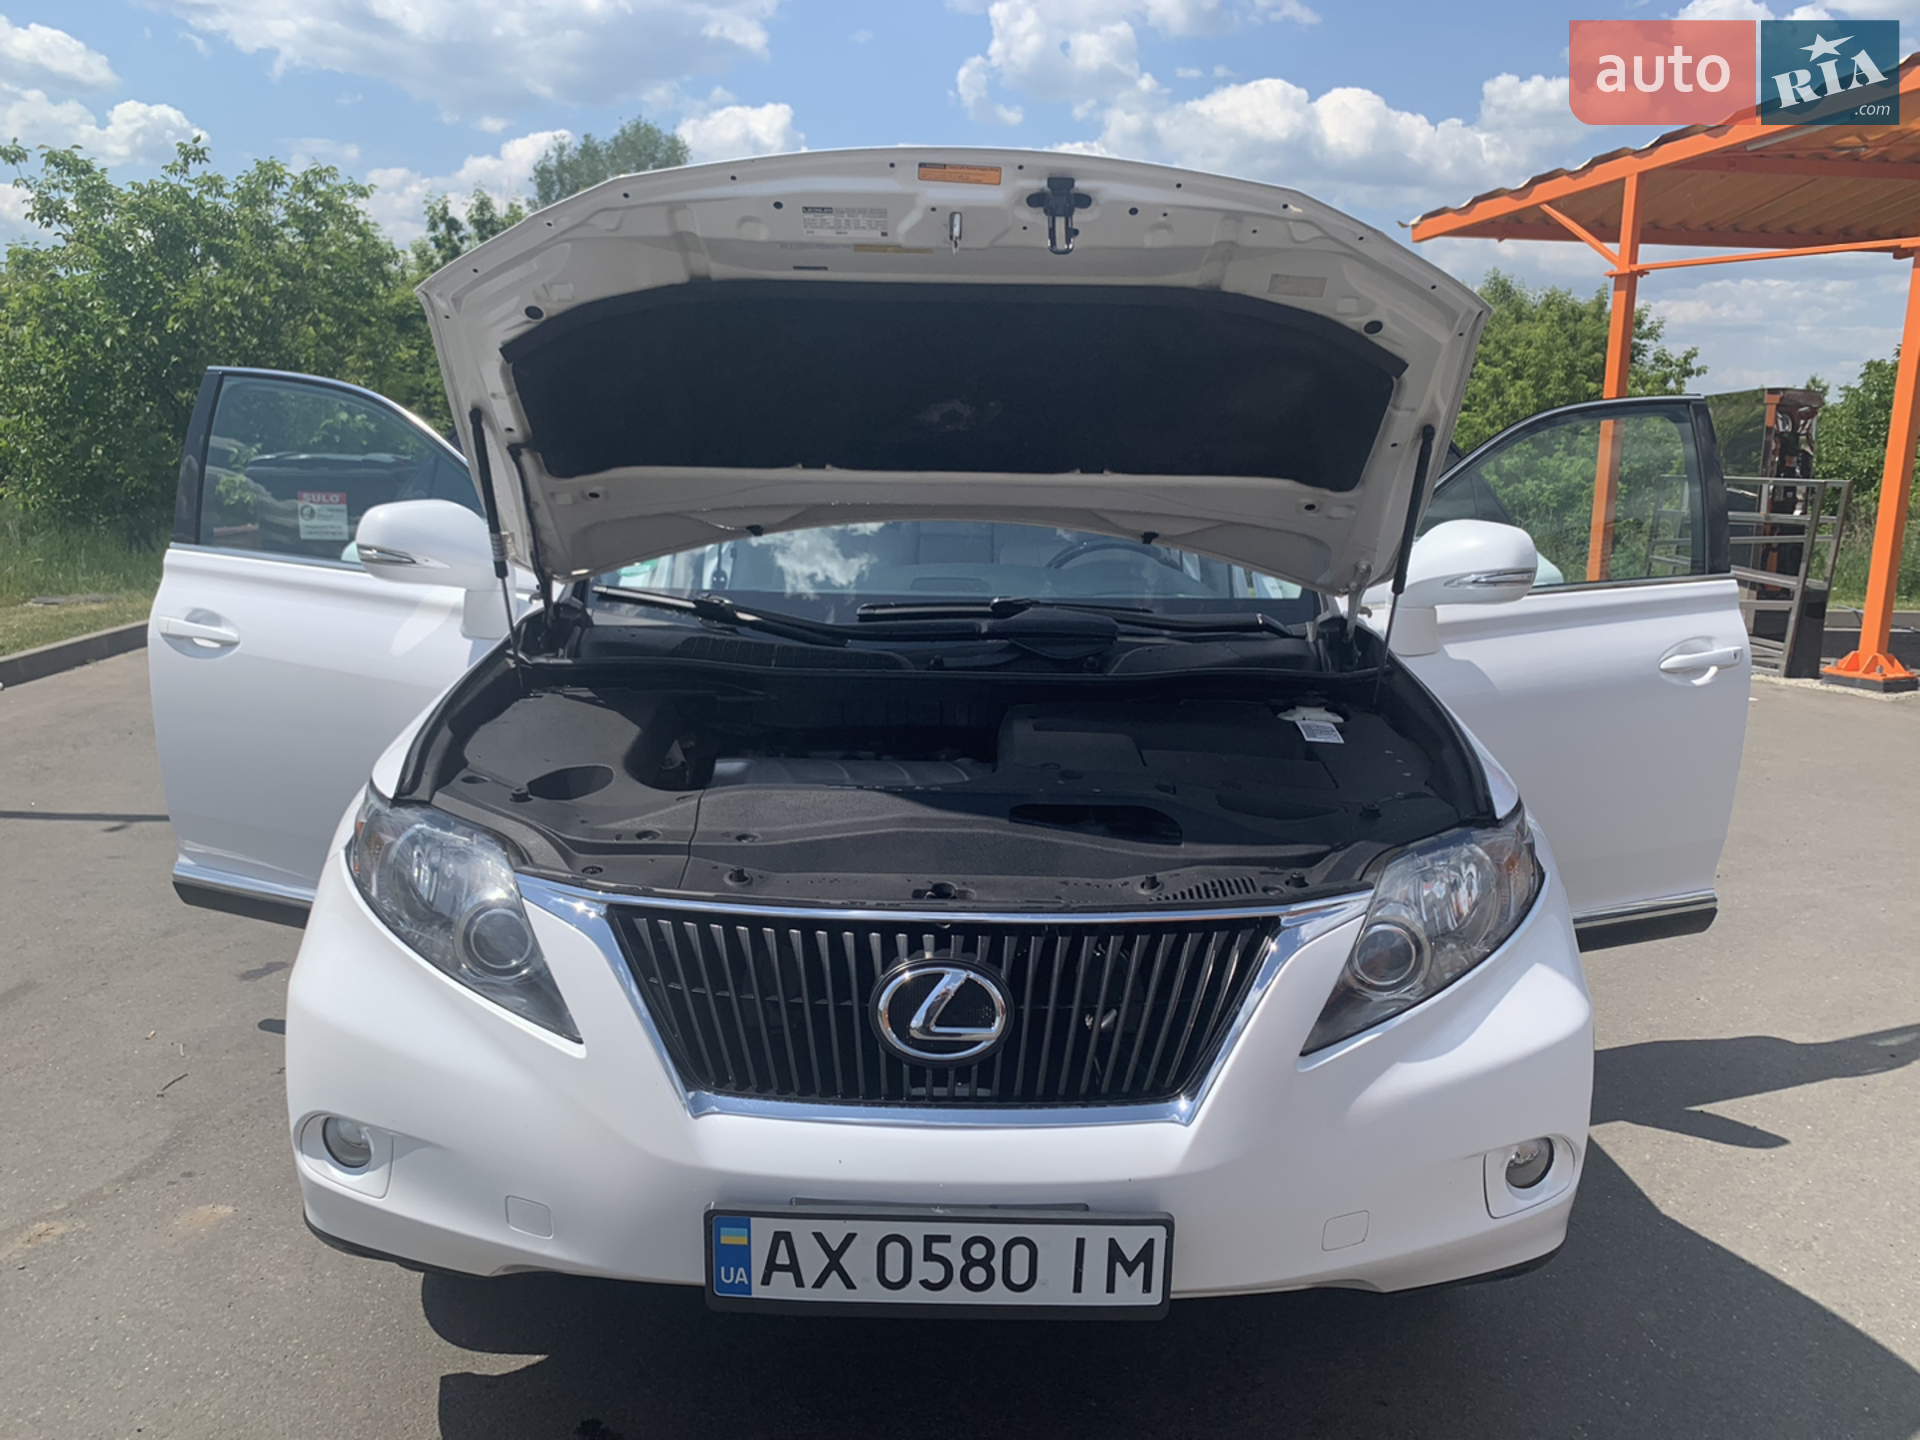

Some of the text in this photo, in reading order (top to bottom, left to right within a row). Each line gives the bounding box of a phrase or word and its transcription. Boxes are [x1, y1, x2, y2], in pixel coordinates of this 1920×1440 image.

[720, 1266, 749, 1285] UA
[760, 1230, 1155, 1294] AX 0580 IM
